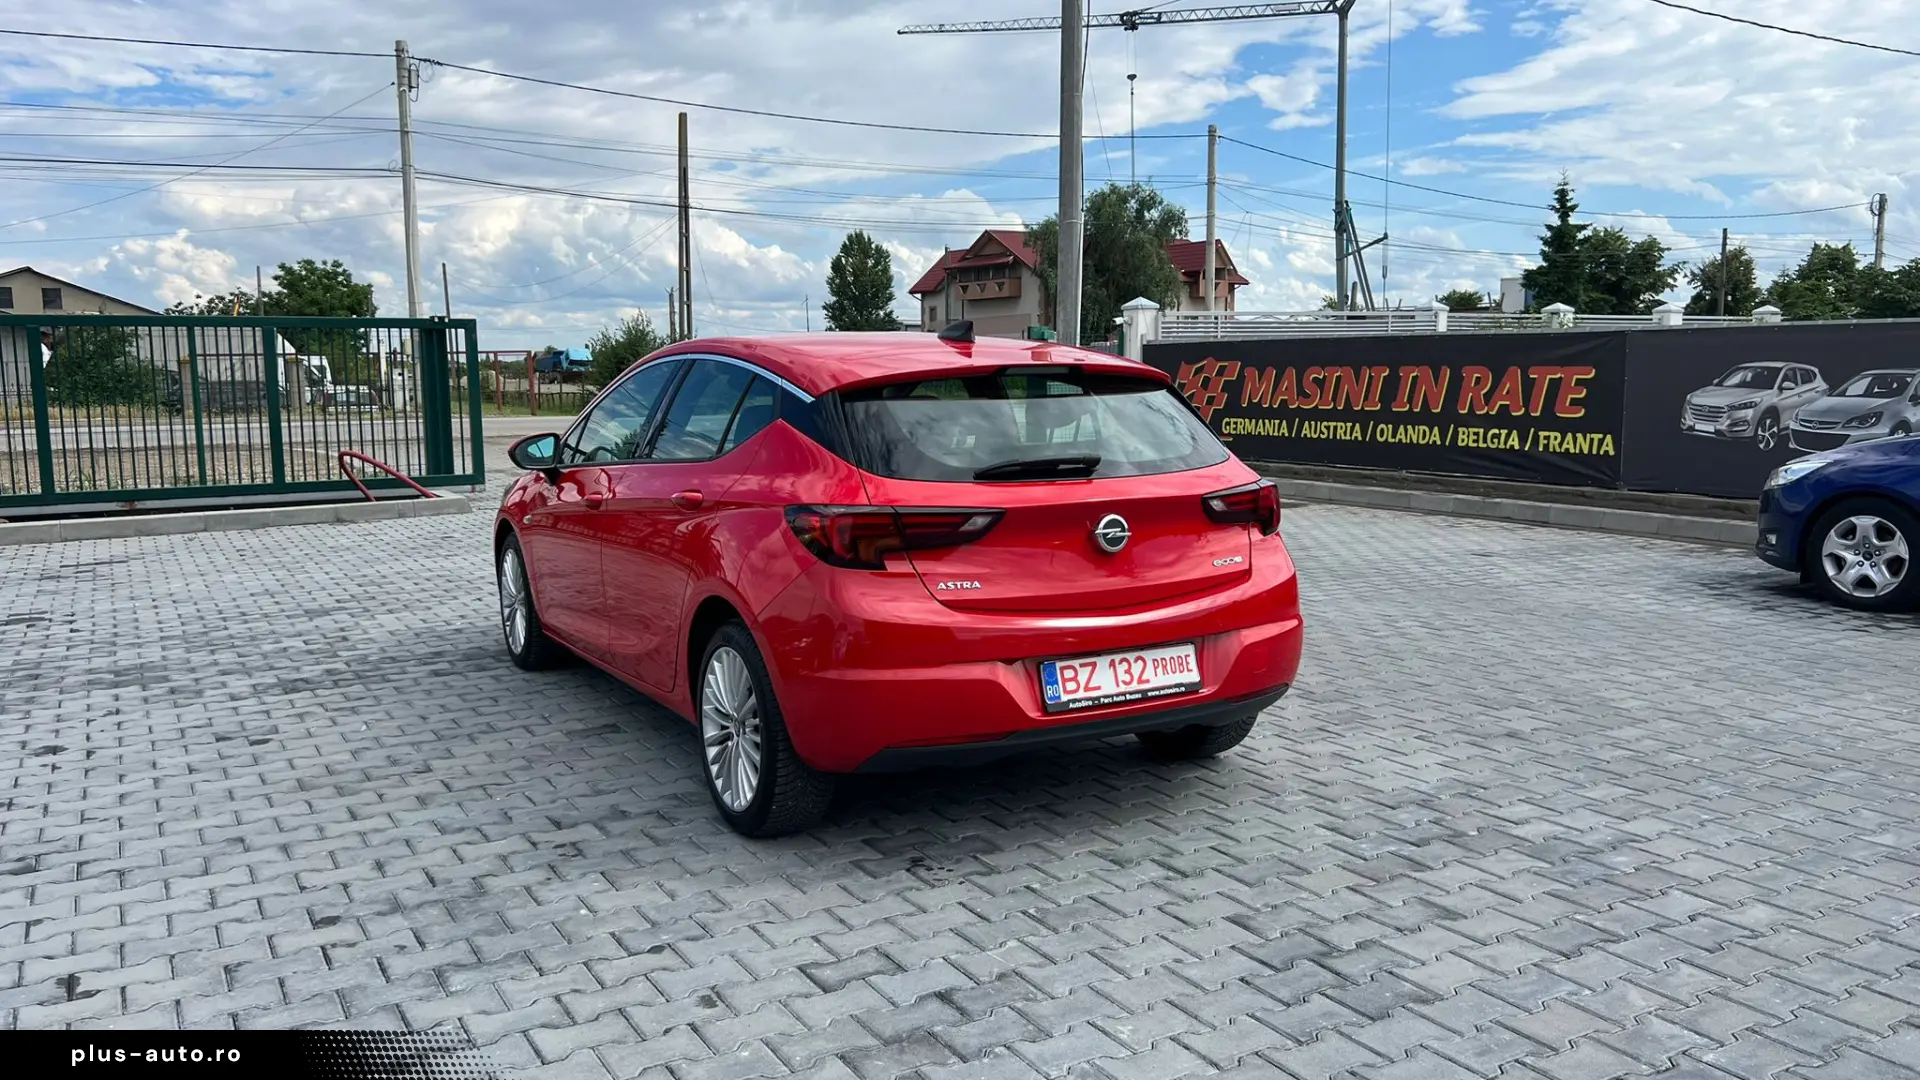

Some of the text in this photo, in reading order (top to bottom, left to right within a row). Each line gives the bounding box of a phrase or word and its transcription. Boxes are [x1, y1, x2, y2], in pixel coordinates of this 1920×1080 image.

[1241, 366, 1596, 418] MASINI IN RATE
[1222, 417, 1615, 456] GERMANIA / AUSTRIA / OLANDA / BELGIA / FRANTA
[936, 580, 982, 591] ASTRA
[1047, 685, 1059, 697] RO
[1060, 654, 1193, 695] BZ 132 PROBE
